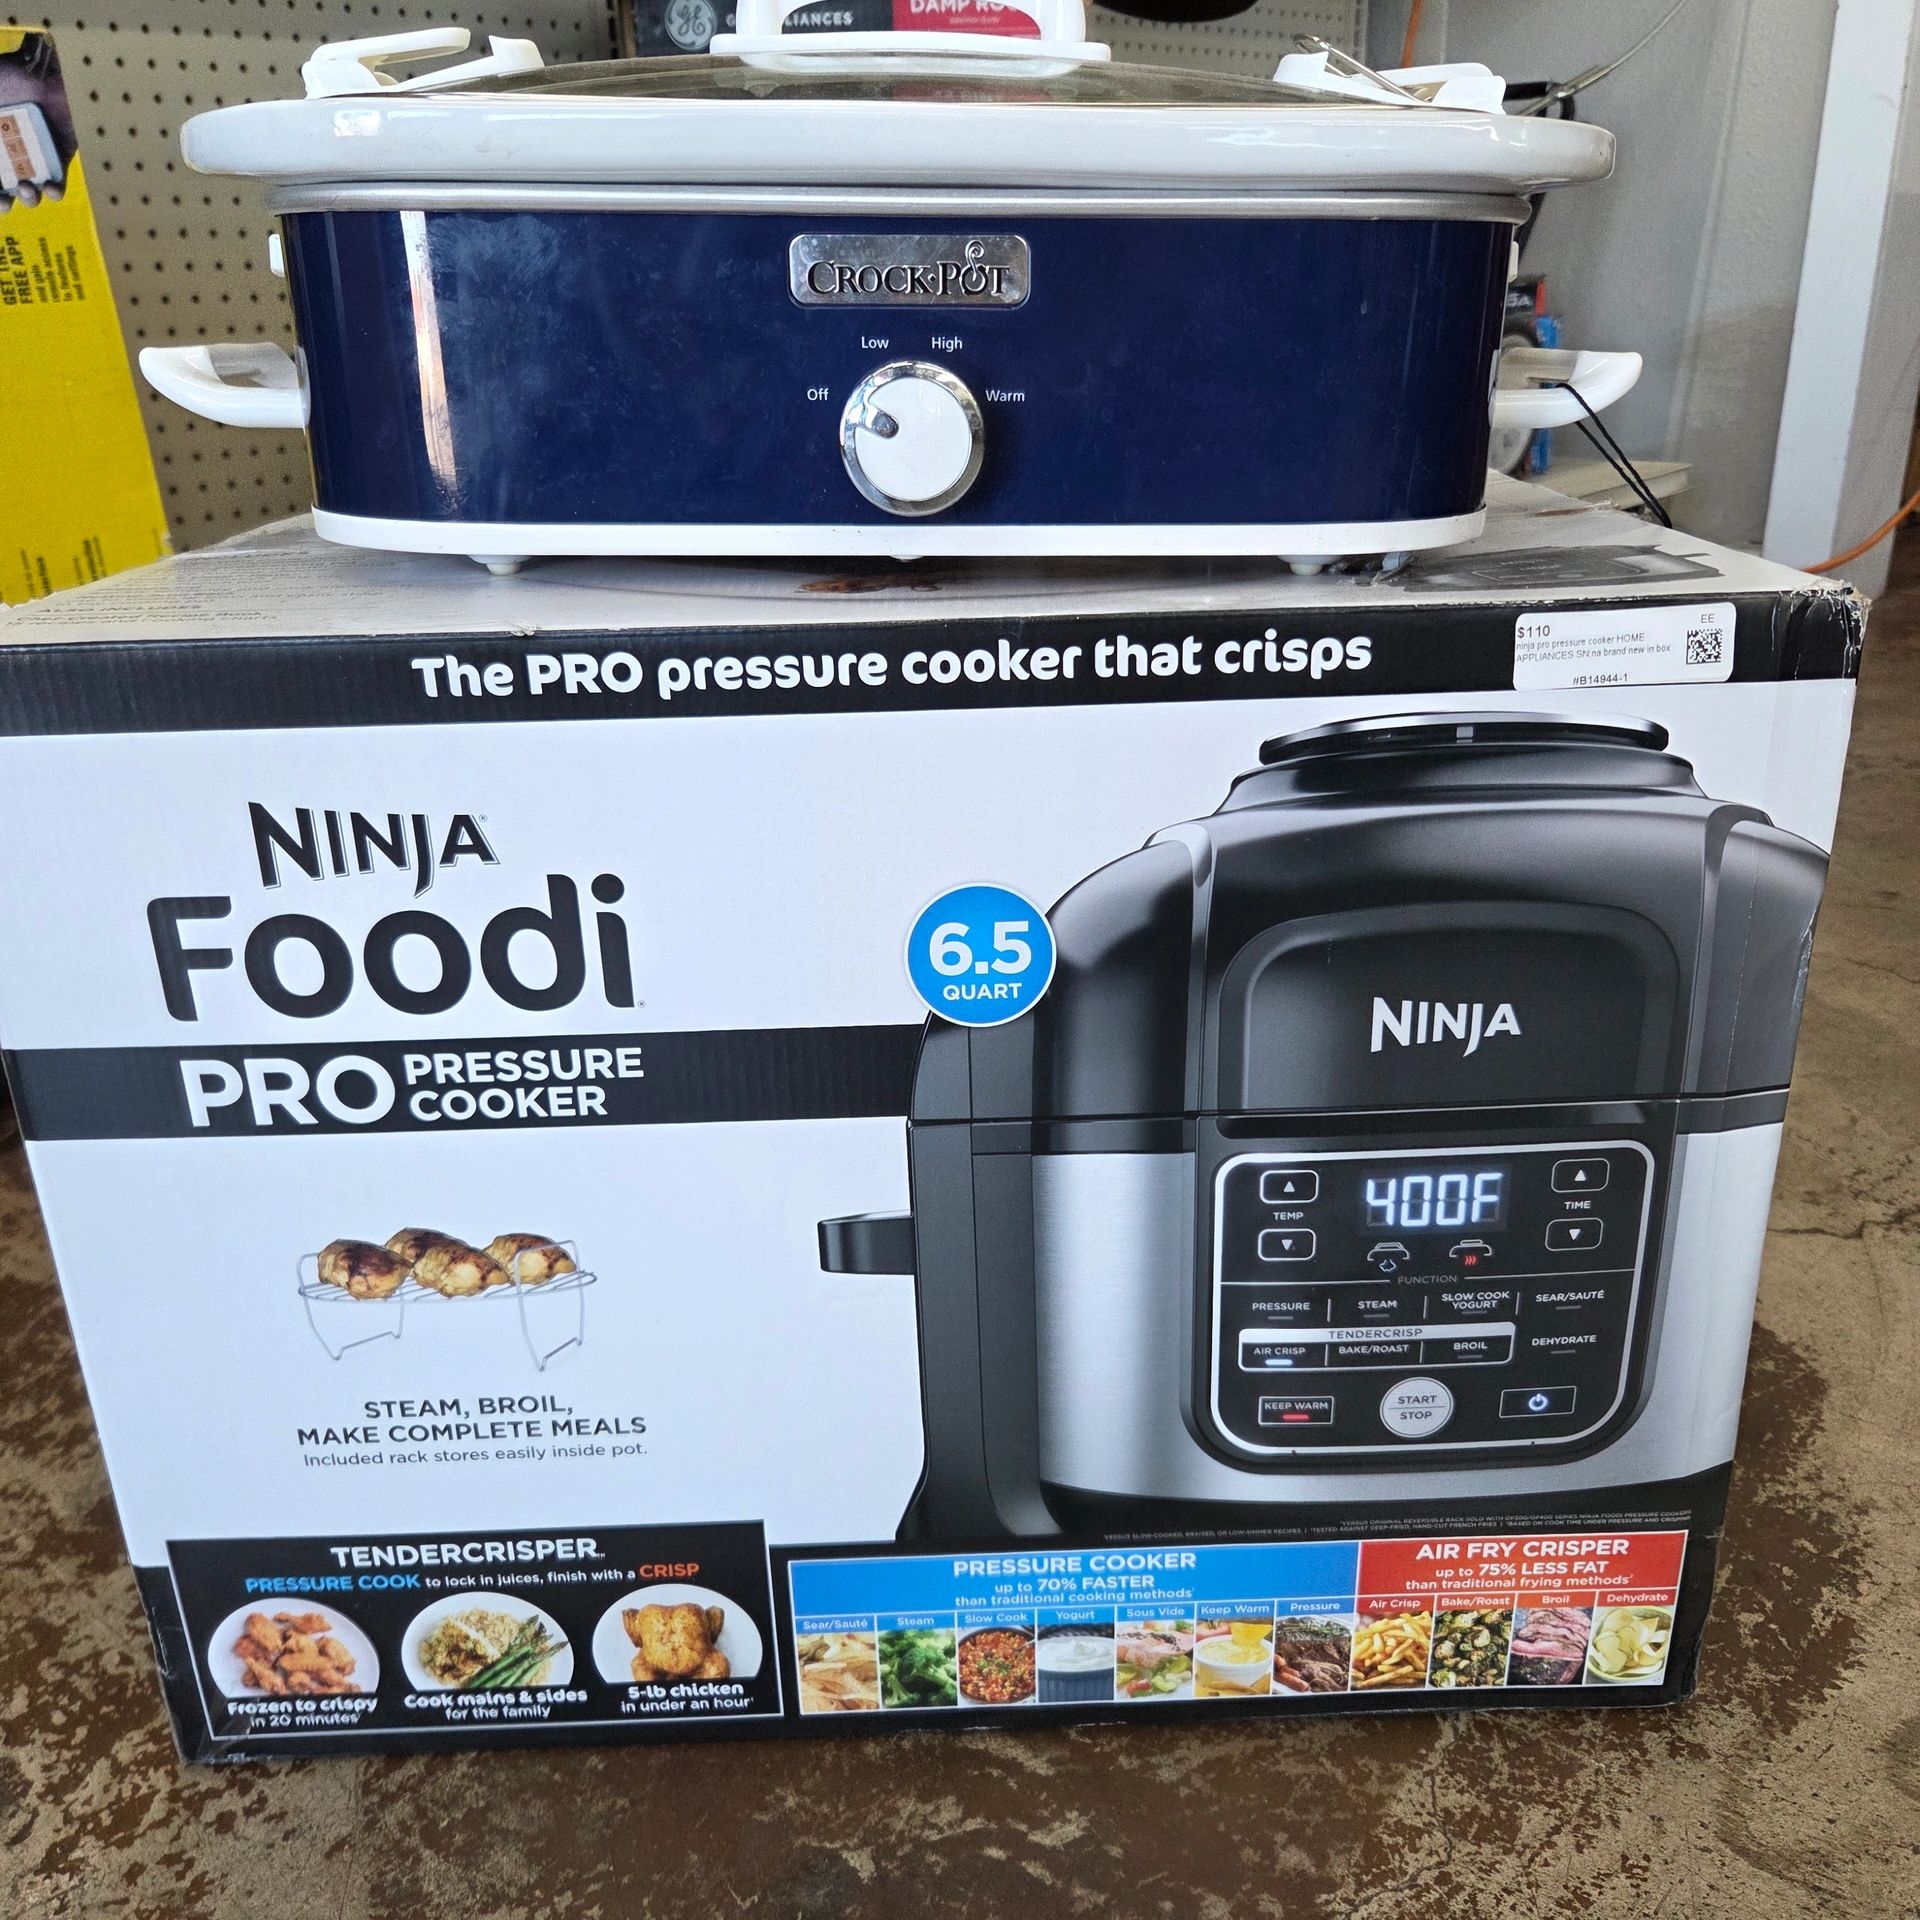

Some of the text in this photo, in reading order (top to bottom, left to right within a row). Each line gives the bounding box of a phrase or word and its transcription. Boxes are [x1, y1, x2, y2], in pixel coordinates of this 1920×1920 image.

[784, 11, 854, 27] LIANCES
[5, 236, 35, 305] FREE APP
[861, 336, 963, 352] Low High
[807, 388, 1025, 402] Off Warm
[1700, 613, 1715, 624] EE
[1517, 624, 1551, 639] $110
[1516, 632, 1645, 652] ninja pro pressure cooker HOME
[1516, 650, 1574, 663] APPLIANCES
[1603, 644, 1627, 657] brand
[1628, 645, 1645, 655] new
[1647, 643, 1655, 653] in
[1656, 642, 1672, 653] box
[410, 628, 1374, 701] The PRO pressure cooker that crisps
[1572, 673, 1628, 686] #B14944-1
[929, 920, 1032, 977] 6.5
[942, 982, 1023, 1001] QUART
[1370, 996, 1523, 1058] NINJA
[179, 1046, 645, 1128] PRO PRESSURE
[410, 1085, 608, 1122] COOKER
[1366, 1172, 1505, 1227] 400F
[1564, 1200, 1591, 1210] TIME
[1273, 1211, 1304, 1221] TEMP
[1397, 1274, 1458, 1285] FUNCTION
[1441, 1290, 1511, 1302] SLOW COOK
[1535, 1289, 1605, 1303] SEAR/SAUTÉ
[1252, 1302, 1311, 1311] PRESSURE
[1357, 1300, 1398, 1310] STEAM
[1452, 1300, 1498, 1310] YOGURT
[1328, 1328, 1423, 1339] TENDERCRISP
[1531, 1334, 1598, 1346] DEHYDRATE
[1254, 1347, 1306, 1356] AIR CRISP
[1338, 1344, 1409, 1355] BAKE/ROAST
[1453, 1341, 1488, 1350] BROIL
[364, 1395, 574, 1419] STEAM, BROIL,
[1264, 1401, 1329, 1410] KEEP WARM
[1397, 1395, 1438, 1405] START
[1400, 1411, 1432, 1420] STOP
[297, 1416, 647, 1446] MAKE COMPLETE MEALS
[303, 1442, 648, 1467] Included rack stores easily inside pot.
[1415, 1538, 1630, 1560] AIR FRY CRISPER
[953, 1551, 1198, 1577] PRESSURE COOKER
[1435, 1560, 1610, 1579] up to 75% LESS FAT
[245, 1562, 700, 1594] PRESSURE COOK to lock in juices, finish with a CRISP
[995, 1574, 1155, 1596] up to 70% FASTER
[1405, 1579, 1437, 1590] than
[1442, 1577, 1516, 1589] traditional
[1520, 1575, 1562, 1589] frying
[955, 1594, 986, 1607] than
[991, 1591, 1064, 1606] traditional
[1068, 1588, 1126, 1604] cooking
[1369, 1597, 1421, 1610] Air Crisp
[1441, 1594, 1511, 1607] Bake/Roast
[1542, 1594, 1570, 1604] Broil
[1606, 1592, 1669, 1605] Dehydrate
[1126, 1605, 1185, 1618] Sous Vide
[1201, 1603, 1270, 1616] Keep Warm
[1290, 1601, 1341, 1612] Pressure
[897, 1616, 935, 1626] Steam
[964, 1612, 1028, 1625] Slow Cook
[1056, 1609, 1096, 1622] Yogurt
[803, 1617, 868, 1630] Sear/Sauté
[404, 1687, 588, 1709] Cook mains & sides
[628, 1682, 745, 1700] 5-lb chicken
[227, 1696, 379, 1715] Frozen to crispy
[445, 1704, 551, 1720] for the family
[621, 1700, 636, 1714] in
[640, 1698, 687, 1714] under
[690, 1699, 710, 1711] an
[250, 1716, 266, 1728] in
[269, 1714, 291, 1728] 20
